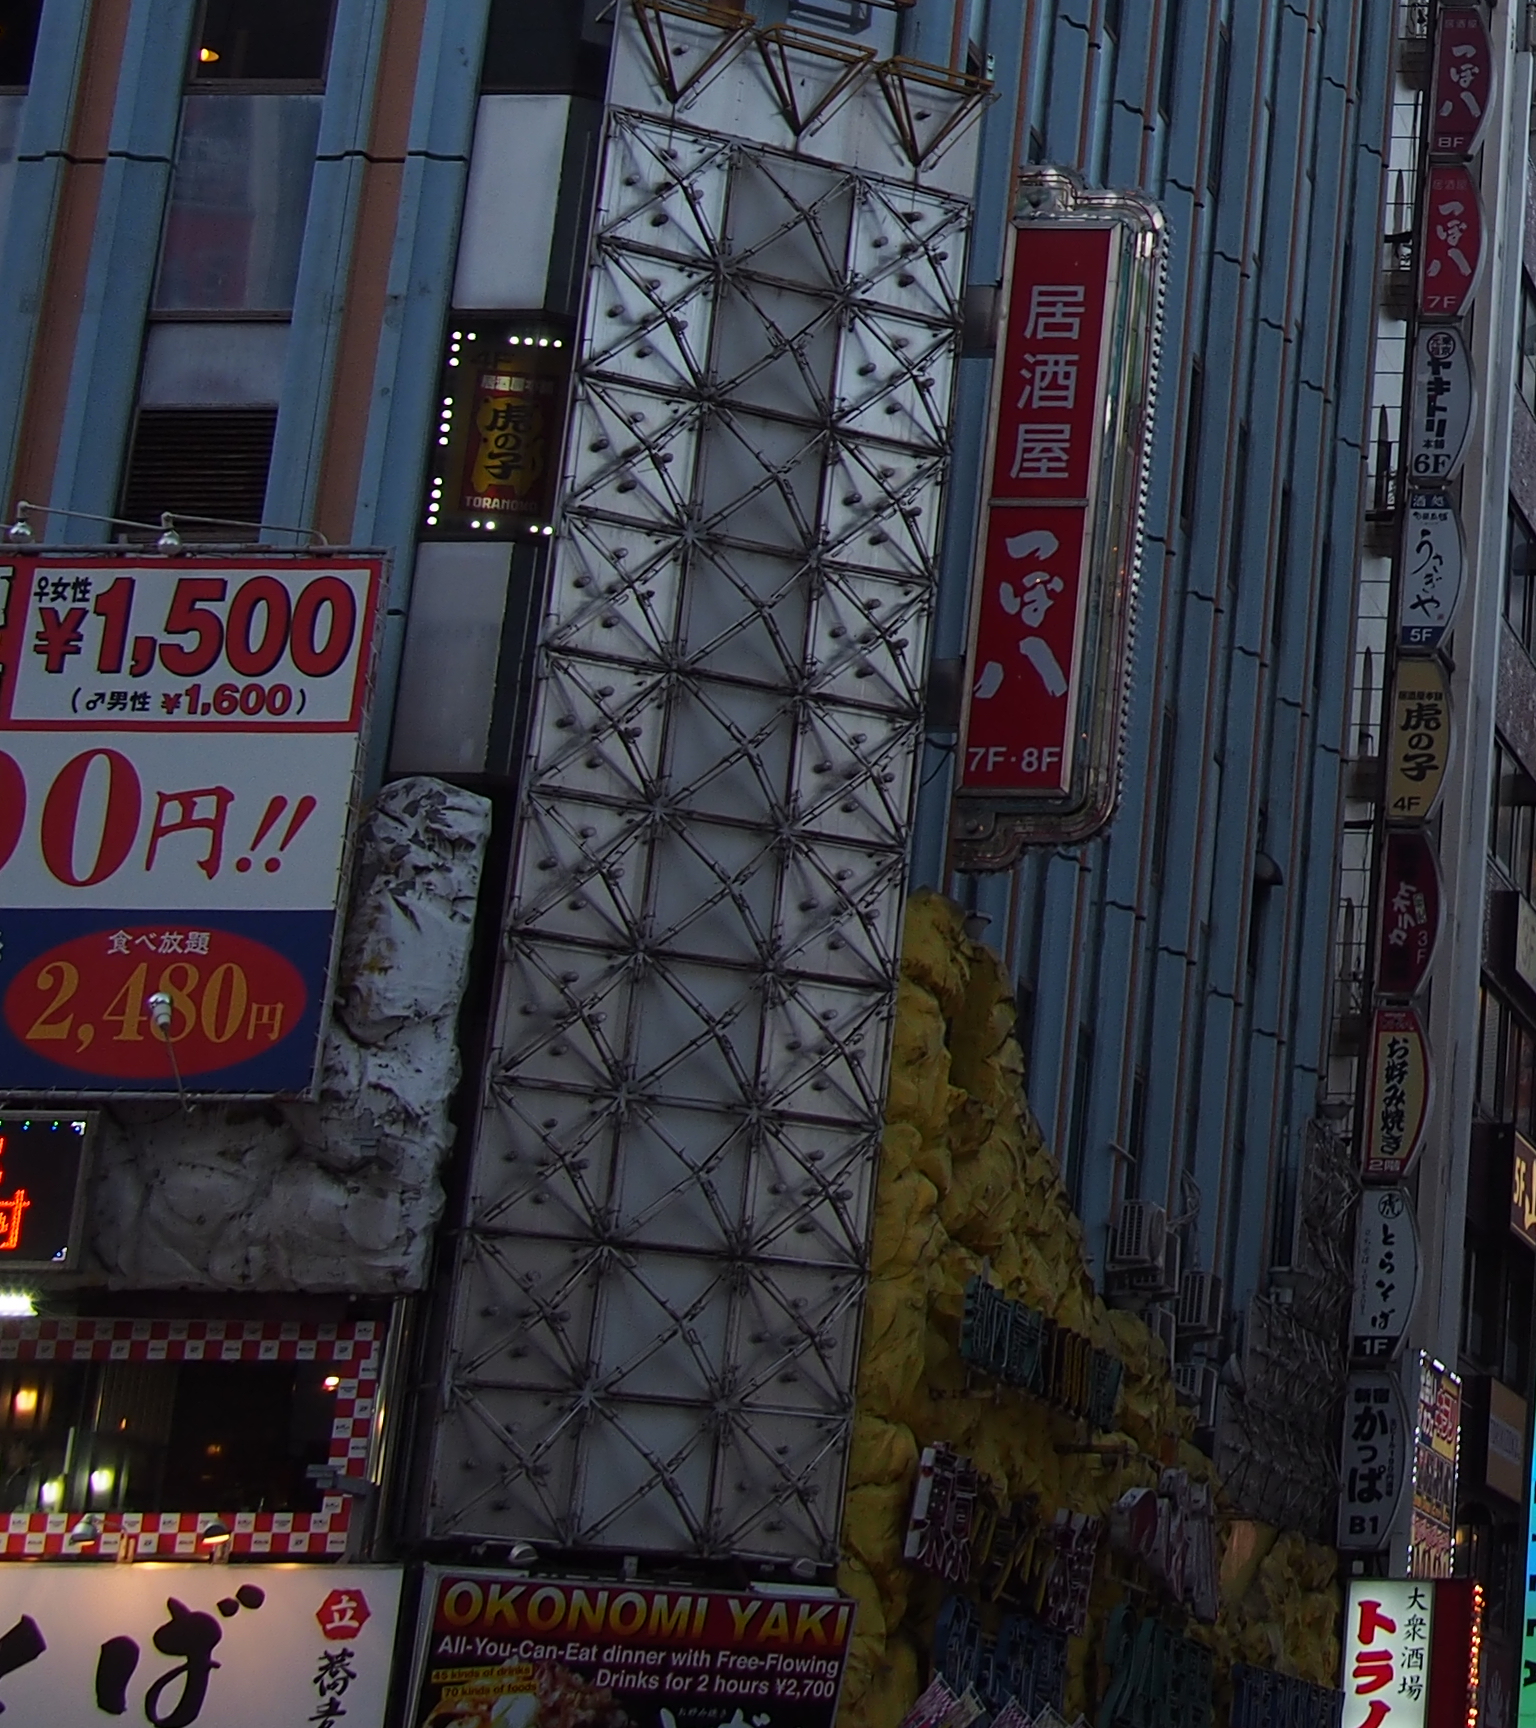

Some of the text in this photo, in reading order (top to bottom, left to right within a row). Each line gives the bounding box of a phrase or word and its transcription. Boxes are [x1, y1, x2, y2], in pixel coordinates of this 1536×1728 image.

[1427, 296, 1456, 309] 7F
[1010, 286, 1085, 481] 居酒屋
[1414, 454, 1451, 474] 6F
[33, 574, 356, 678] ¥1,500
[974, 529, 1068, 699] つぼ八
[1409, 628, 1433, 642] 5F
[106, 683, 293, 717] 男性 ¥1,600
[1400, 703, 1442, 782] 虎の子
[1393, 796, 1421, 811] 4F
[107, 931, 210, 954] 食べ放題
[1371, 1224, 1397, 1330] とらそば
[1363, 1338, 1389, 1354] 1F
[1355, 1388, 1389, 1403] 新宿
[1349, 1405, 1388, 1503] かっぱ
[1350, 1517, 1378, 1534] B1
[326, 1595, 360, 1630] 立
[442, 1579, 850, 1646] OKONOMI YAKI
[438, 1636, 840, 1677] All-You-Can-Eat dinner with Free-Flowing
[1398, 1587, 1429, 1701] 大衆酒場
[444, 1682, 537, 1696] 70 kinds foods
[596, 1669, 835, 1699] Drinks for 2 hours ¥2,700
